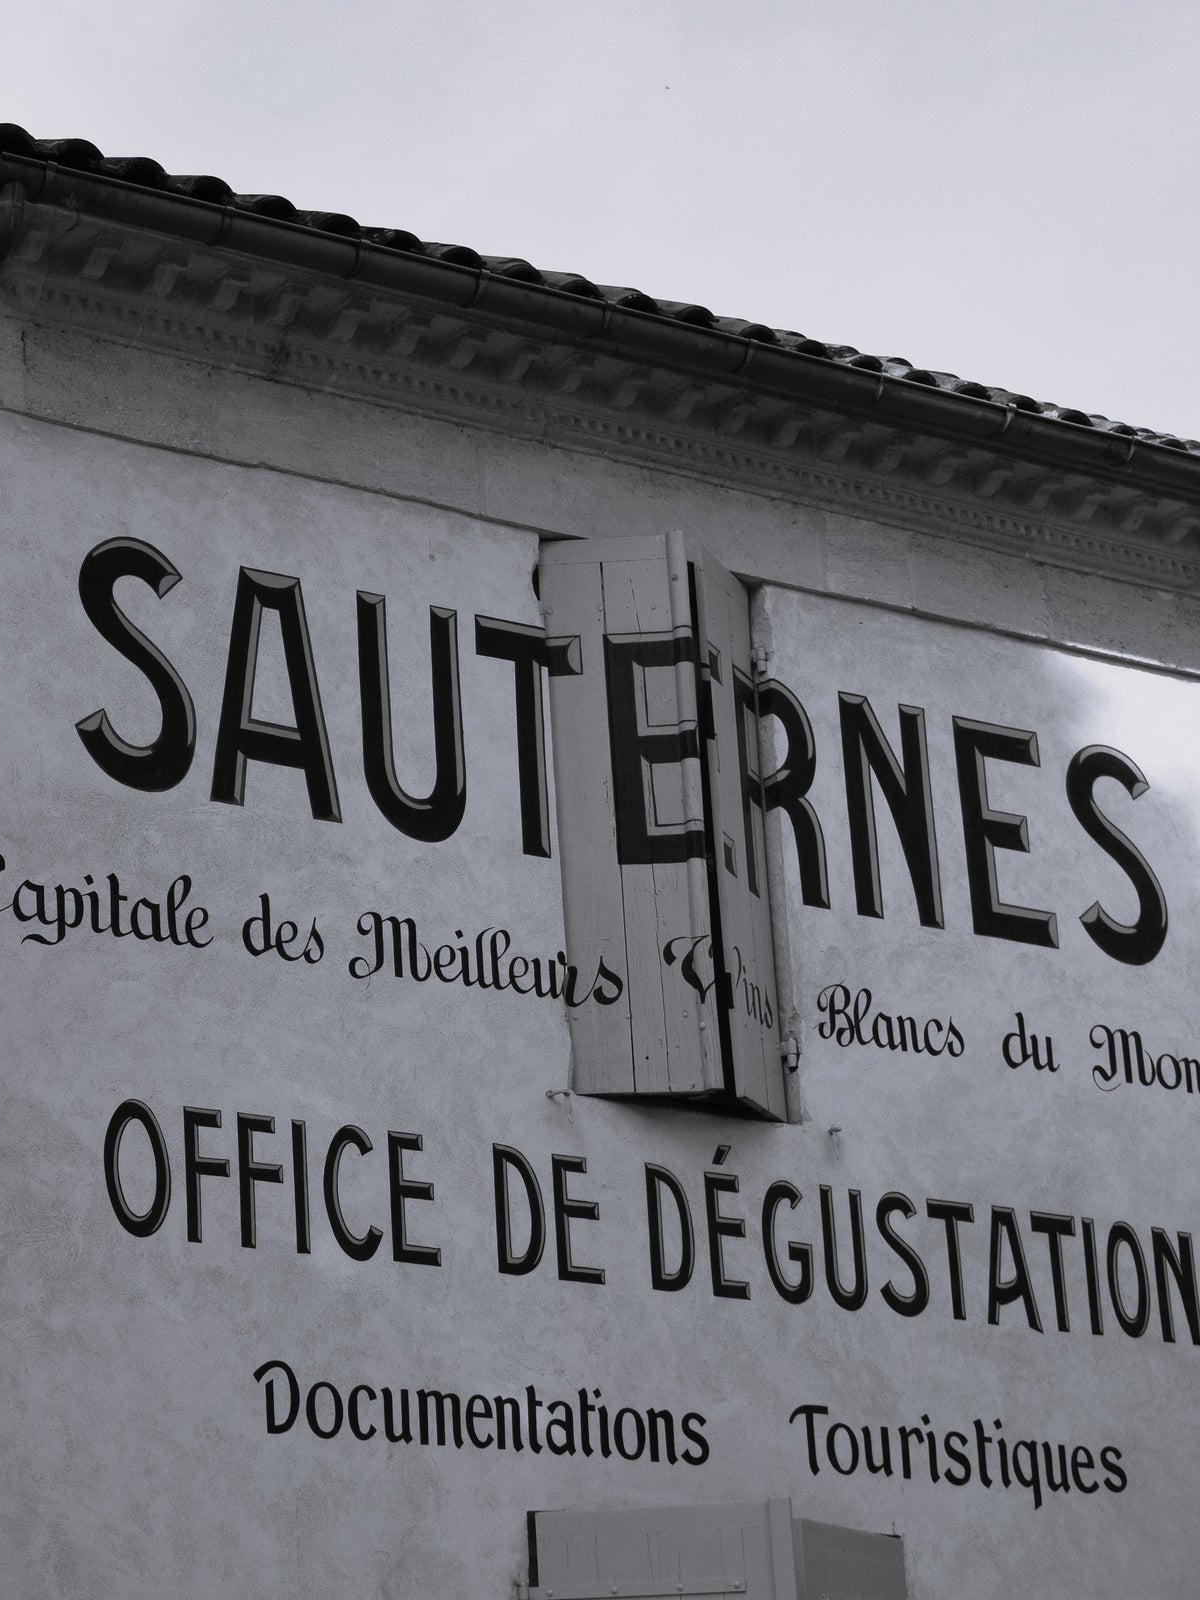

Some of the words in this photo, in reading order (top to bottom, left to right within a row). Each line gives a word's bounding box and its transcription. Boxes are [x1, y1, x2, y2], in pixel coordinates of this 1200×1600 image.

[75, 536, 1168, 966] SAUTERNES
[241, 893, 325, 965] des
[348, 911, 624, 1008] Meilleurs
[662, 933, 774, 1029] Vins
[812, 979, 966, 1058] Blancs
[1002, 1011, 1061, 1073] du
[103, 1098, 442, 1267] OFFICE
[491, 1141, 606, 1286] DE
[644, 1144, 1200, 1347] DÉGUSTATION
[252, 1359, 711, 1466] Documentations
[788, 1404, 1128, 1510] Touristiques
